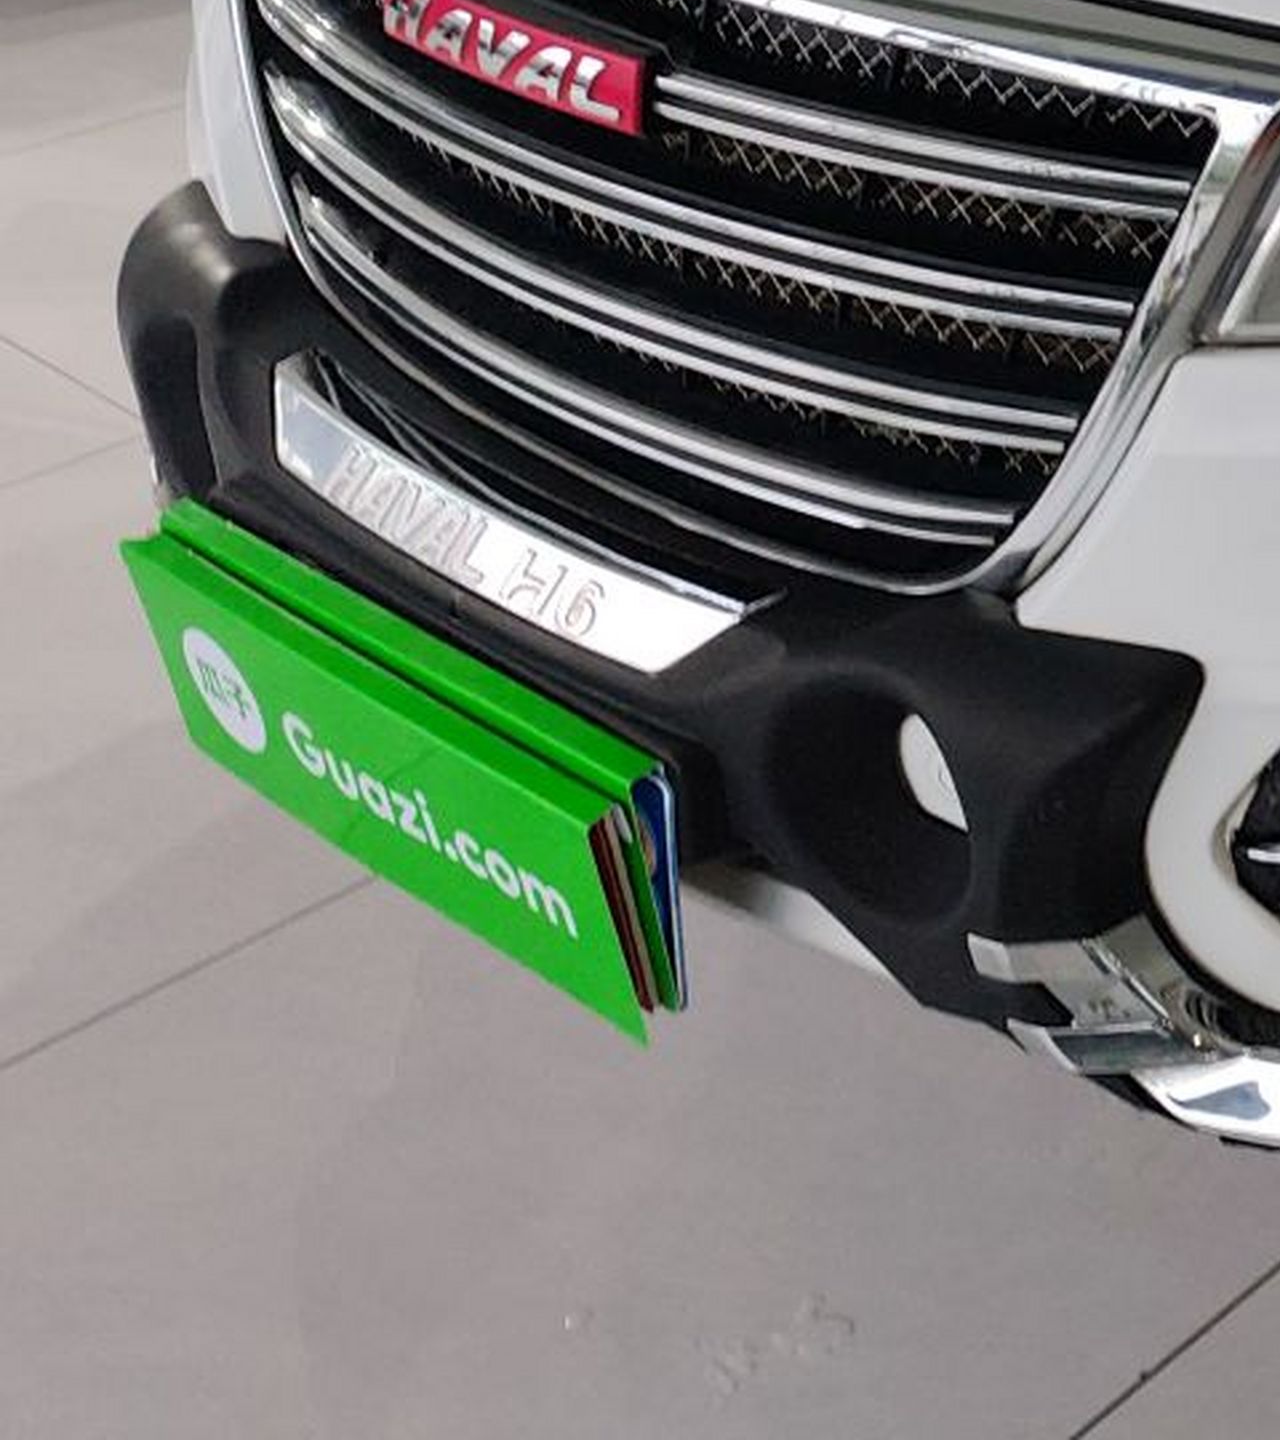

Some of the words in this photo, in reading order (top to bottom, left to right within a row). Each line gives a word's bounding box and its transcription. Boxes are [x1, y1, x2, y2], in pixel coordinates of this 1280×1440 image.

[322, 447, 489, 586] HAVAL
[498, 546, 607, 637] H6
[281, 710, 581, 940] Guazi.com
